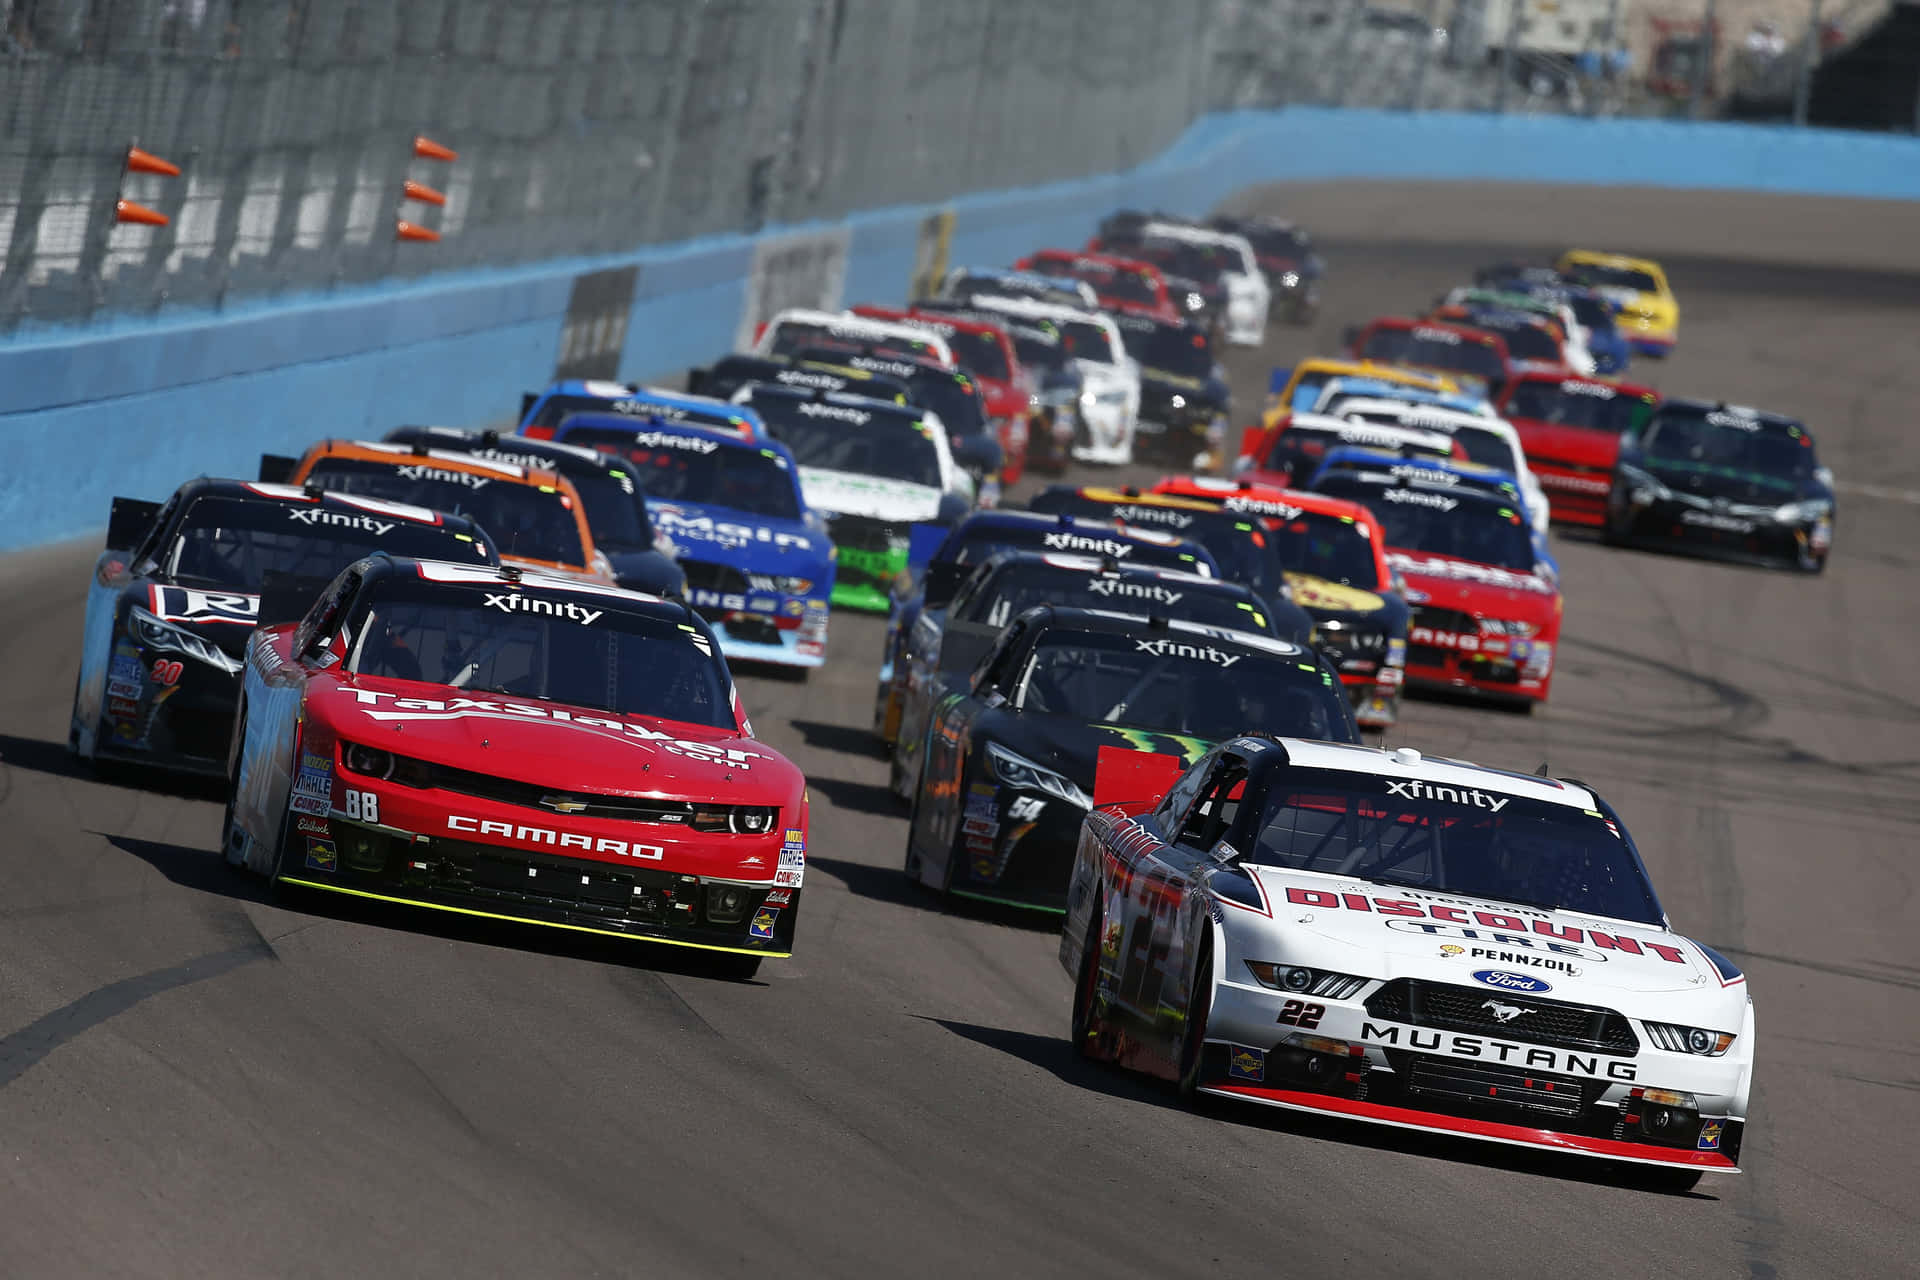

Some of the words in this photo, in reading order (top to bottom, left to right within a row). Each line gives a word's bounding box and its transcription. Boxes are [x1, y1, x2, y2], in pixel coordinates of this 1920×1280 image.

[635, 431, 719, 454] xfinity
[470, 448, 556, 470] xfinity
[397, 464, 491, 489] xfinity
[288, 506, 396, 536] xfinity
[1112, 504, 1193, 528] xfinity
[1223, 495, 1303, 519] xfinity
[1043, 531, 1133, 558] xfinity
[1088, 577, 1183, 606] xfinity
[483, 593, 603, 625] xfinity
[1136, 639, 1240, 667] xfinity
[150, 658, 184, 686] 20
[346, 789, 379, 823] 88
[1008, 795, 1048, 822] 54
[1386, 779, 1509, 813] xfinity
[447, 814, 664, 862] CAMARO
[1285, 887, 1686, 965] DISCOUNT
[1408, 922, 1587, 957] TIRE
[1472, 948, 1575, 974] PENNZOIL
[1485, 970, 1537, 991] Ford
[1276, 1001, 1325, 1030] 22
[1360, 1022, 1639, 1082] MUSTANG
